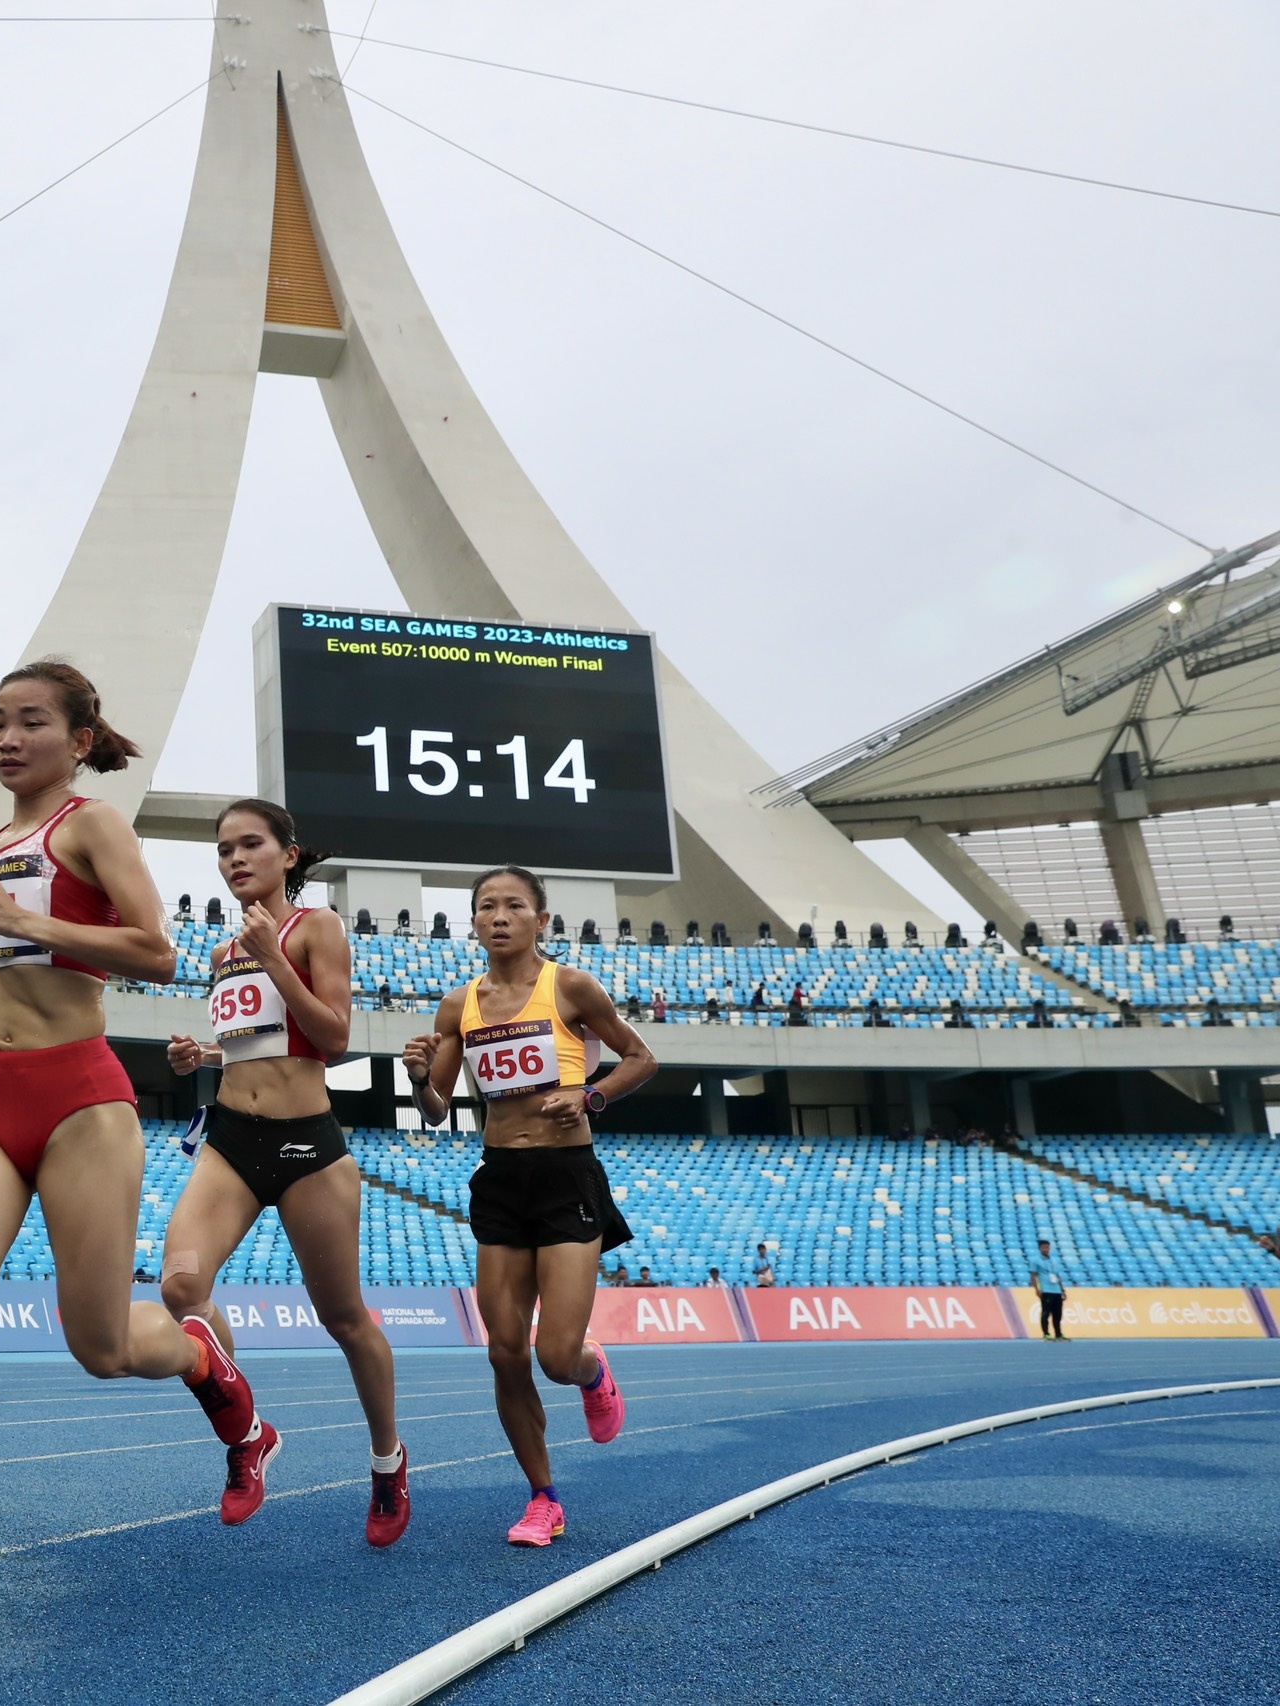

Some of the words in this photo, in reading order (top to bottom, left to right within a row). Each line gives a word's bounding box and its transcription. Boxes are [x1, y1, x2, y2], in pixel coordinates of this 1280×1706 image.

[302, 613, 355, 630] 32nd
[360, 618, 401, 633] SEA
[406, 621, 478, 639] GAMES
[483, 626, 629, 651] 2023-Athletics
[326, 638, 377, 655] Event
[381, 642, 471, 662] 507:10000
[474, 651, 491, 663] m
[494, 650, 558, 668] Women
[562, 656, 603, 671] Final
[355, 725, 596, 804] 15:14
[220, 965, 232, 976] SEA
[211, 984, 262, 1027] 559
[474, 1032, 490, 1042] 32nd
[491, 1029, 507, 1038] SEA
[508, 1024, 540, 1036] GAMES
[477, 1044, 544, 1082] 456
[279, 1151, 317, 1159] LI-NING
[226, 1305, 265, 1328] BA
[381, 1308, 416, 1316] NATIONAL
[416, 1308, 436, 1316] BANK
[384, 1317, 395, 1325] OF
[395, 1317, 423, 1325] CANADA
[423, 1317, 447, 1325] GROUP
[636, 1297, 706, 1333] AIA
[789, 1296, 862, 1330] AIA
[905, 1296, 976, 1329] AIA
[1062, 1301, 1138, 1325] ellcard
[1168, 1301, 1255, 1325] cellcard
